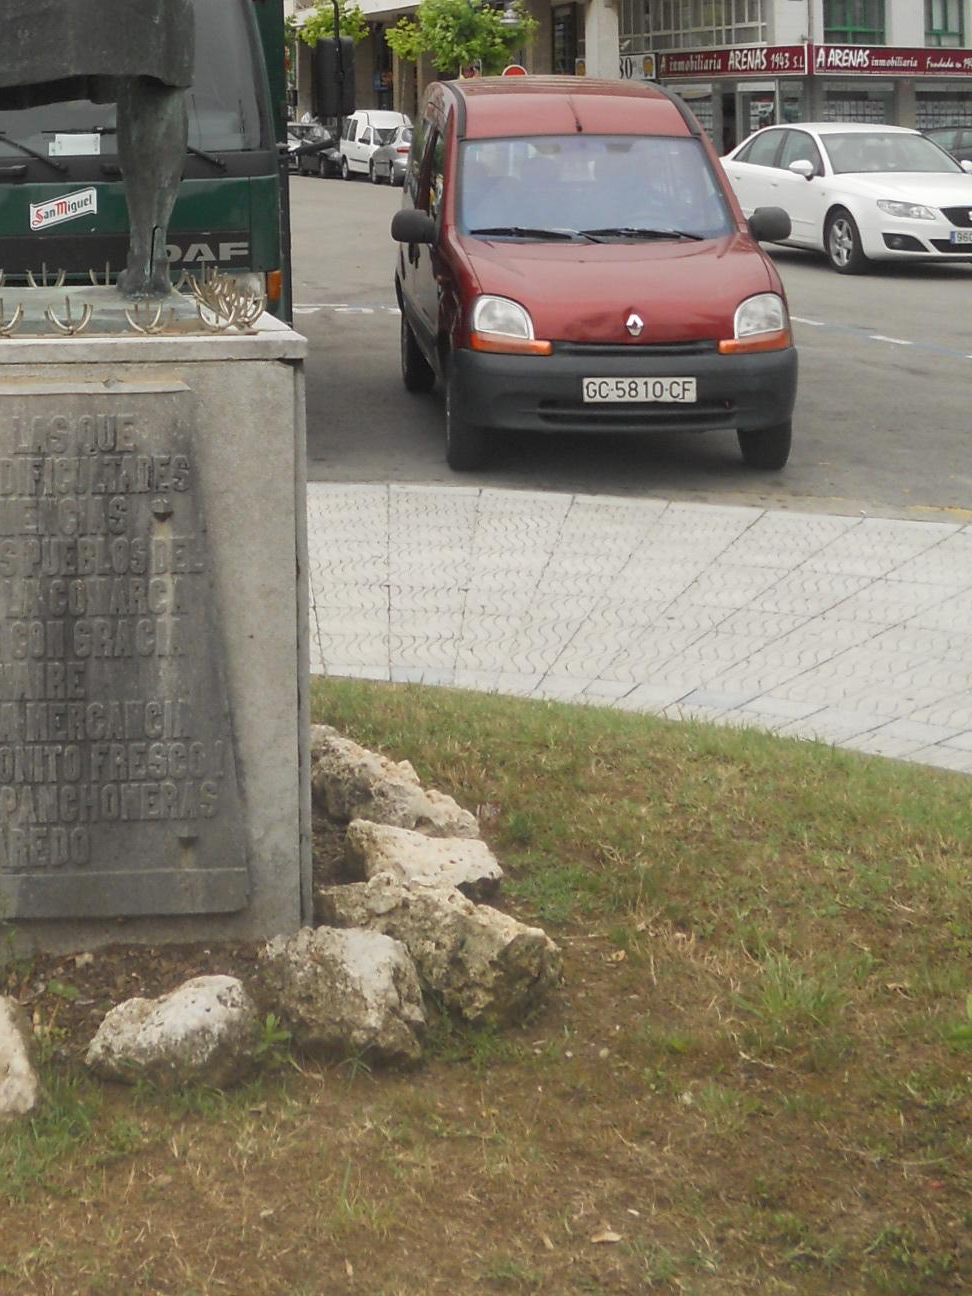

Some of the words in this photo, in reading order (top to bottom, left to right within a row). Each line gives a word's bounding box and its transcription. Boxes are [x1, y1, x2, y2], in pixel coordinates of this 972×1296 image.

[669, 55, 722, 72] inmobiliaria
[728, 48, 767, 71] ARENAS
[771, 53, 789, 69] 1943
[816, 47, 826, 68] A
[827, 48, 870, 68] ARENAS
[871, 55, 918, 68] inmobiliaria
[32, 208, 56, 226] San
[54, 194, 93, 217] Miguel
[166, 242, 249, 262] DAF
[12, 415, 69, 456] LAS
[75, 414, 137, 455] QUE
[0, 455, 191, 495] DIFICULTADES
[23, 538, 148, 578] PUEBLOS
[152, 537, 205, 576] DEL
[2, 580, 41, 619] LA
[10, 620, 66, 660] CON
[73, 618, 186, 659] GRACIA
